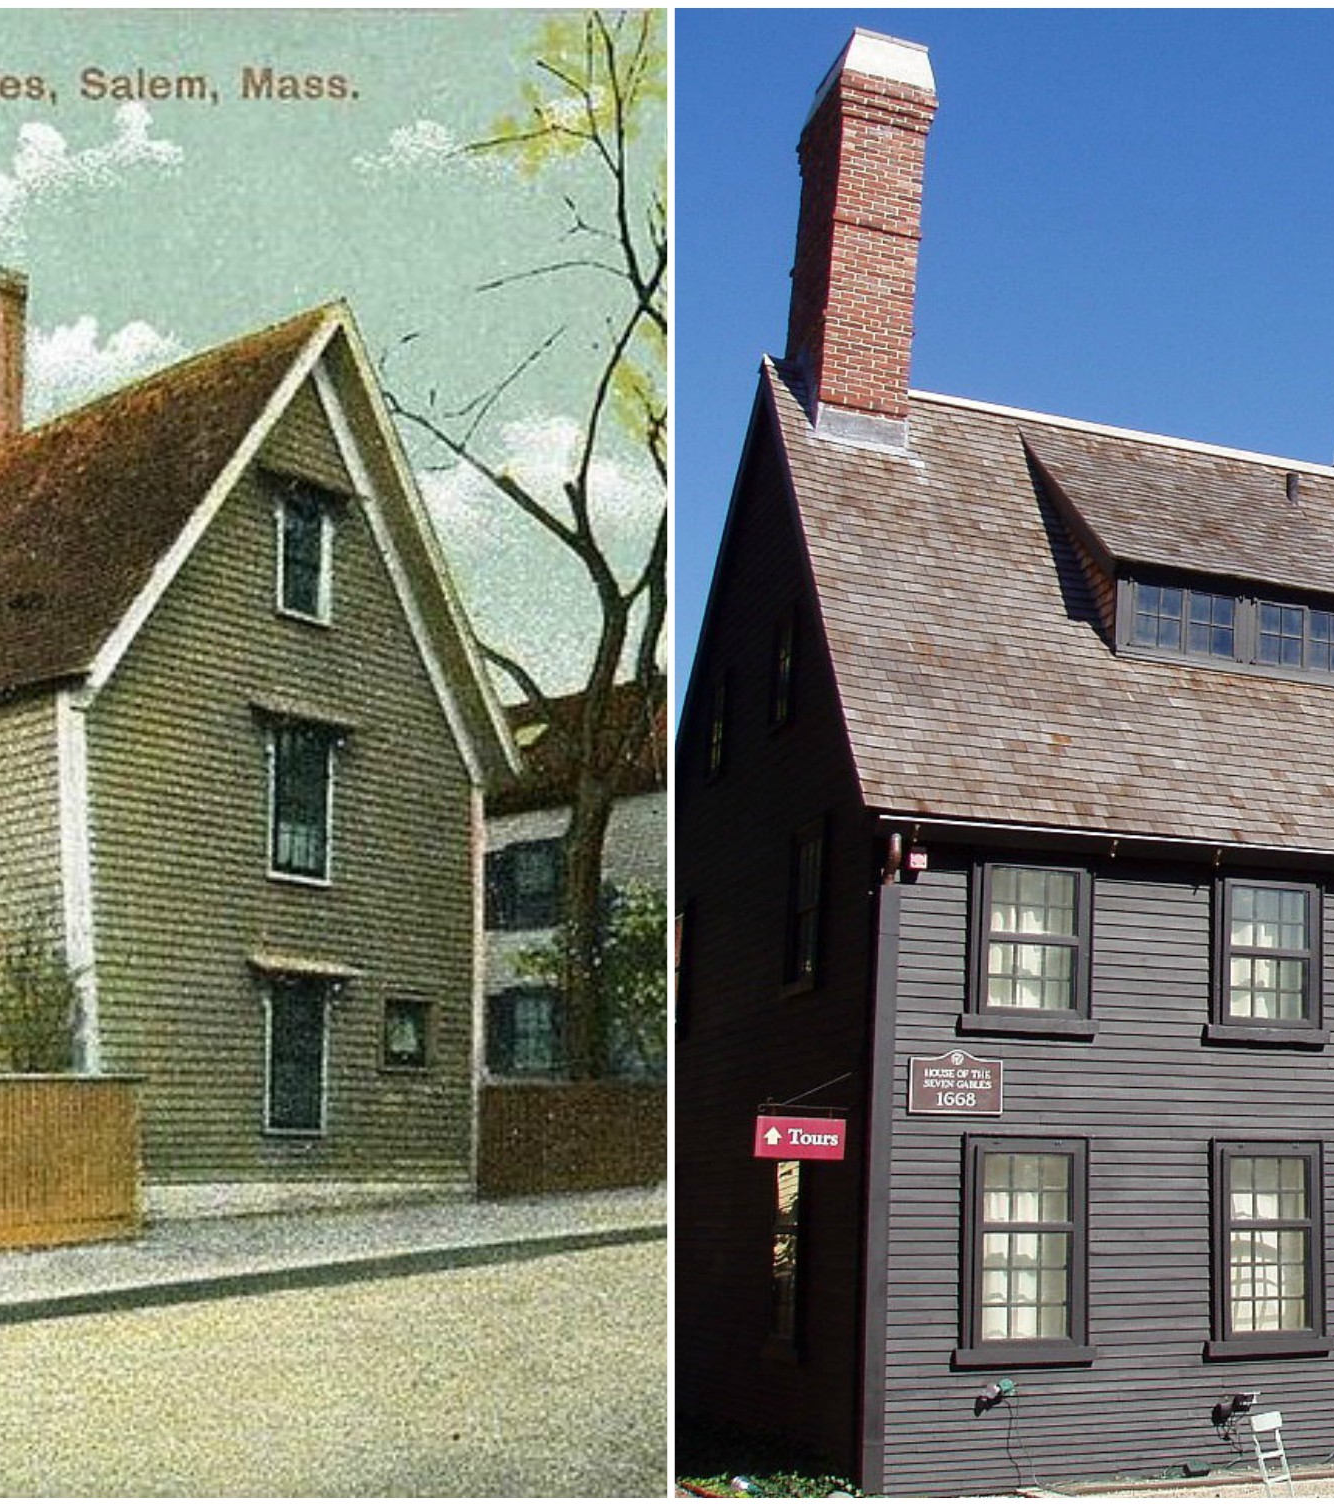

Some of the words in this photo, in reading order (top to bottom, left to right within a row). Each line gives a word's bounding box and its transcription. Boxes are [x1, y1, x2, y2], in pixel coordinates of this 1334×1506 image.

[924, 1068, 955, 1078] HOUSE
[957, 1069, 969, 1078] OF
[971, 1069, 991, 1080] THE
[923, 1079, 955, 1088] SEVEN
[956, 1080, 992, 1089] GABLES
[936, 1091, 976, 1107] 1668
[787, 1128, 839, 1147] Tours
